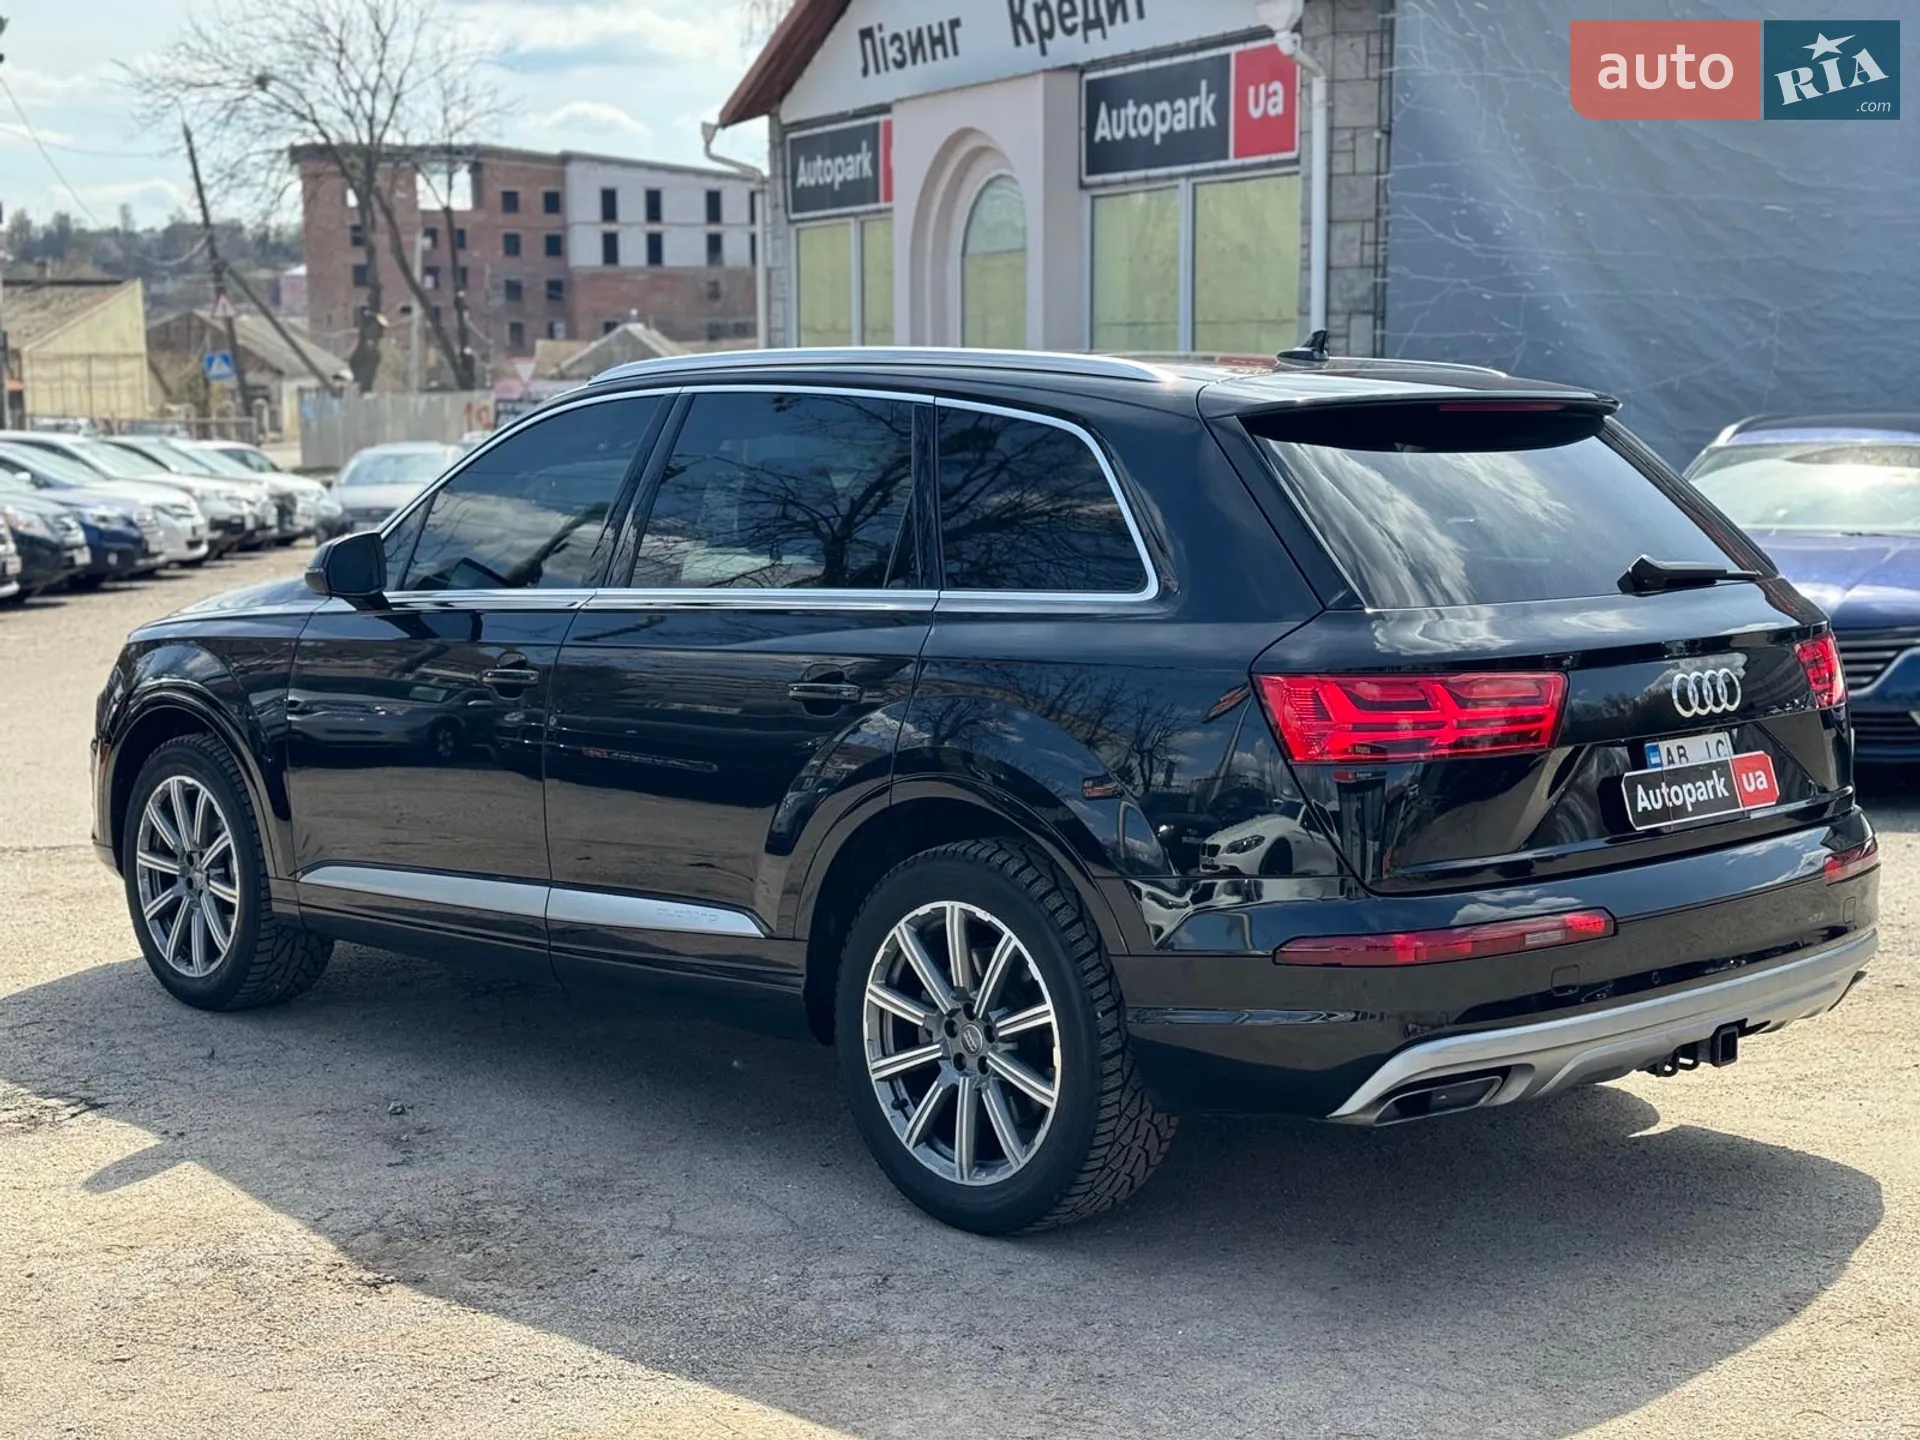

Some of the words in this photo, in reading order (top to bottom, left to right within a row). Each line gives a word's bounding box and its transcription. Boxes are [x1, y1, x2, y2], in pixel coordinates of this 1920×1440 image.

[858, 16, 962, 78] Лізинг
[1094, 79, 1217, 145] Autopark
[1248, 80, 1285, 119] ua
[796, 139, 873, 191] Autopark
[1636, 769, 1730, 812] Autopark
[1741, 769, 1769, 793] ua
